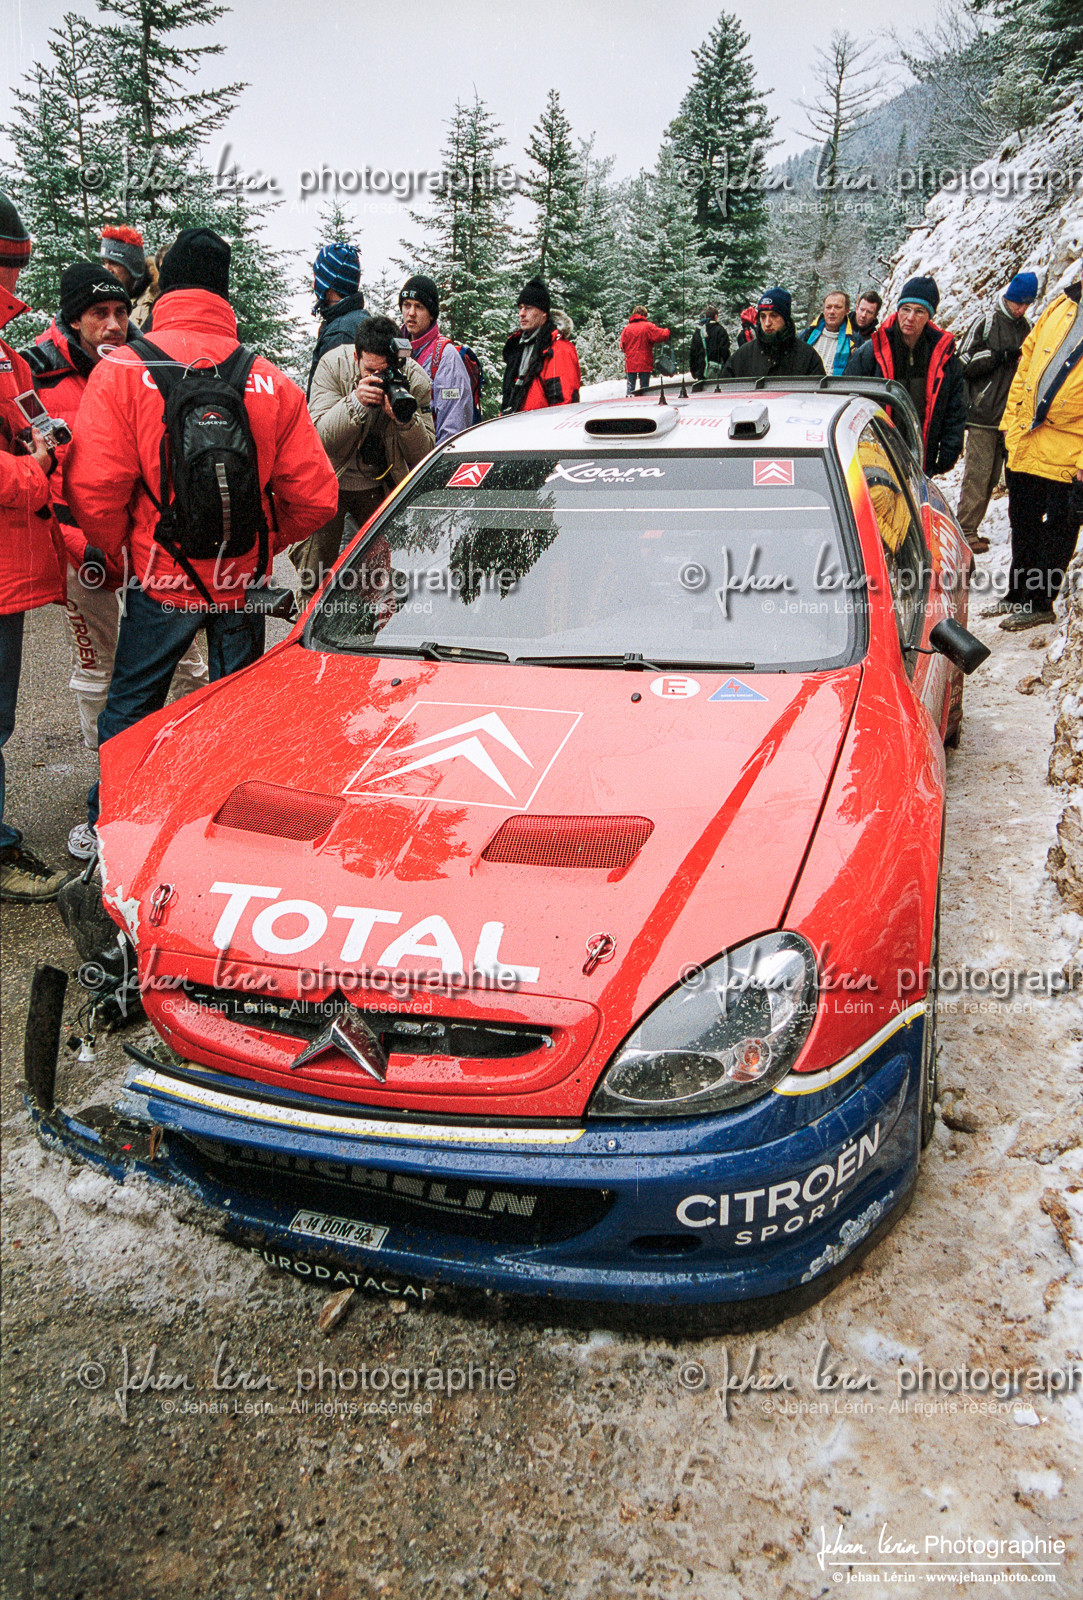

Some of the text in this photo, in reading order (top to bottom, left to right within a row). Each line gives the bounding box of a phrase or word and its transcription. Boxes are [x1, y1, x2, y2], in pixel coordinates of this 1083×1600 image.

[545, 461, 666, 483] Xsara
[662, 679, 688, 696] E
[209, 881, 541, 984] TOTAL
[676, 1122, 880, 1228] CITROËN
[305, 1216, 320, 1231] 14
[320, 1219, 356, 1238] DDM
[734, 1190, 844, 1246] SPORT
